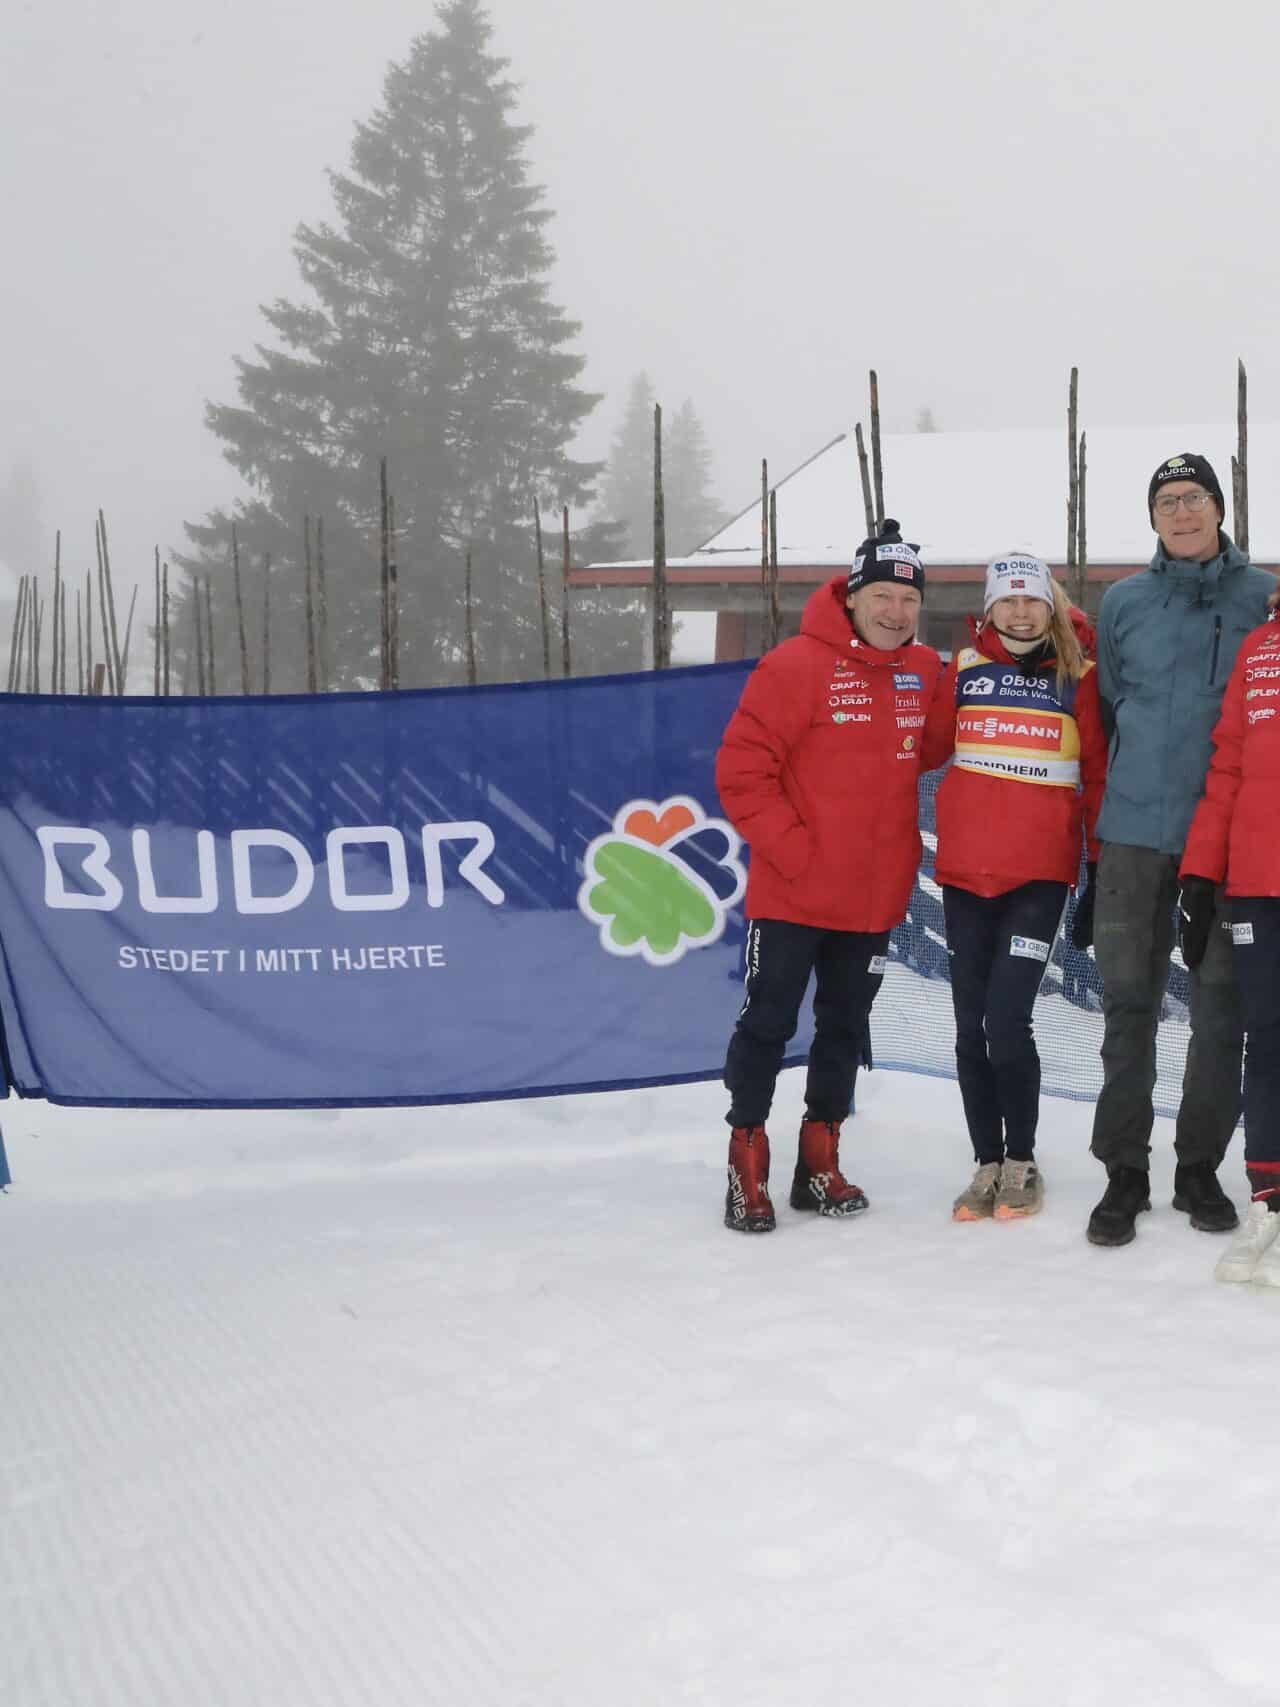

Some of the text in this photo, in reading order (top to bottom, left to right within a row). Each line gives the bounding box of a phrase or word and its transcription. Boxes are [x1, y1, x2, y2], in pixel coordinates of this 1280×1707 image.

[1158, 466, 1196, 479] BUDOR
[1010, 561, 1039, 572] OBOS
[1246, 653, 1277, 664] CRAFT
[830, 681, 860, 690] CRAFT
[1001, 674, 1048, 690] OBOS
[1000, 687, 1028, 697] Block
[841, 697, 872, 705] KRAFT
[832, 713, 872, 722] VEFLEN
[959, 717, 1060, 739] VIESSMANN
[37, 820, 505, 914] BUDOR
[752, 928, 761, 967] CRAFT
[118, 944, 446, 972] STEDET I MITT HJERTE
